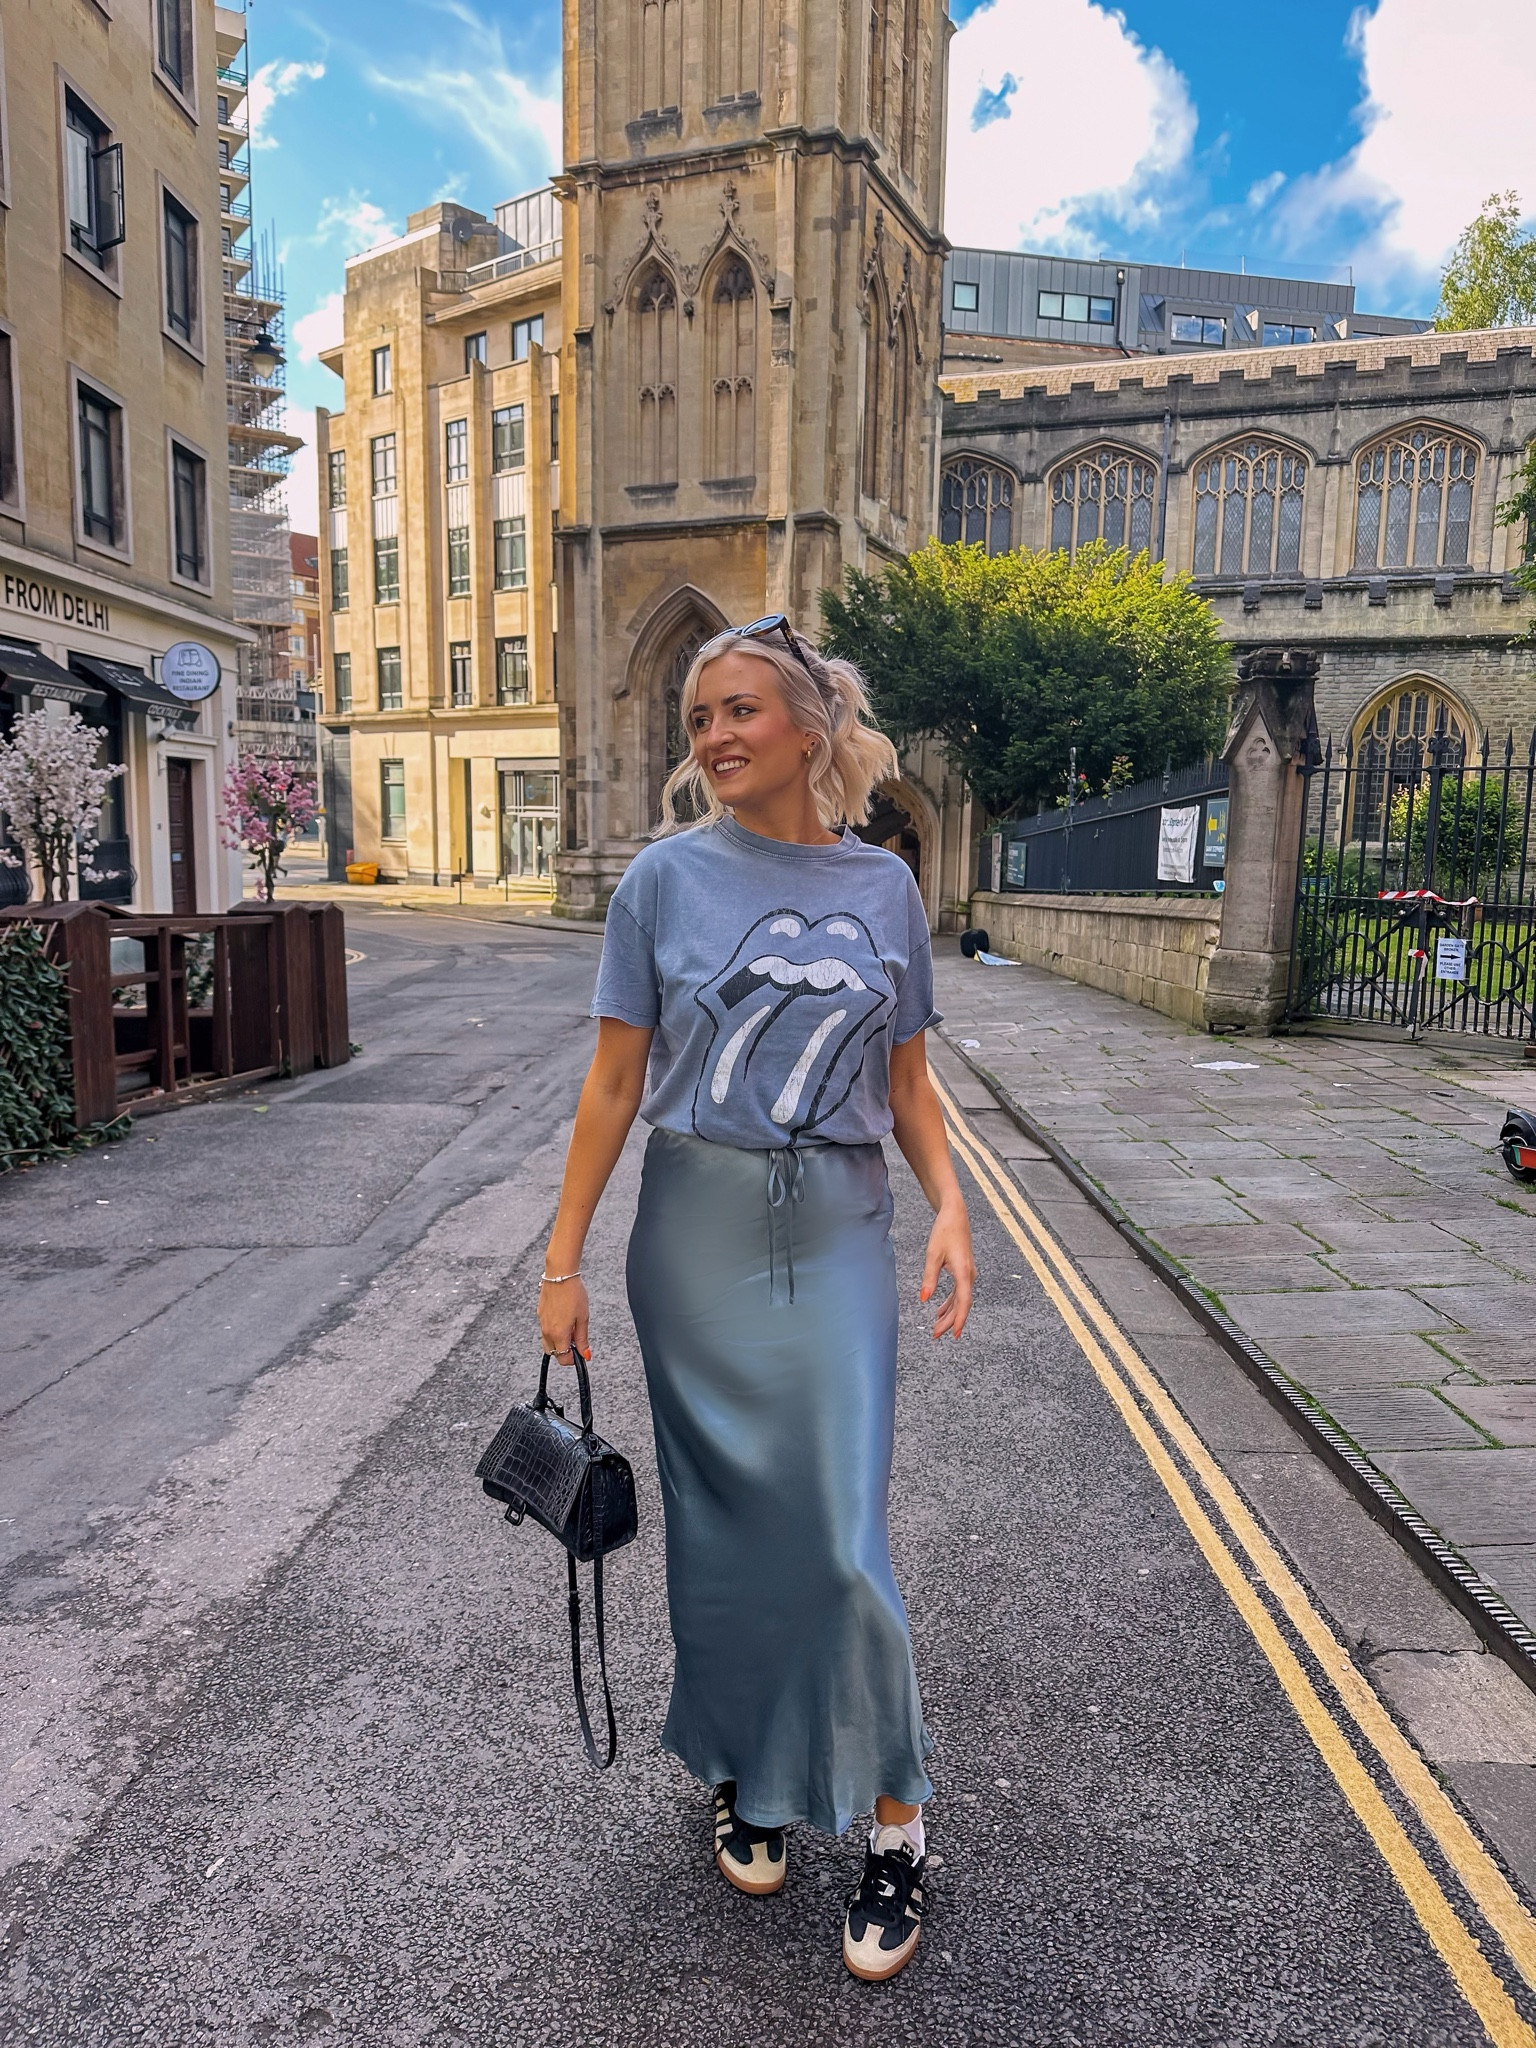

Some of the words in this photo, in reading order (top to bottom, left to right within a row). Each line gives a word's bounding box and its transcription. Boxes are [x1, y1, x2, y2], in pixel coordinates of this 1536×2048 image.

[5, 574, 58, 617] FROM
[63, 592, 109, 631] DELHI
[31, 683, 87, 703] RESTAURANT
[147, 704, 182, 719] COCKTAILS
